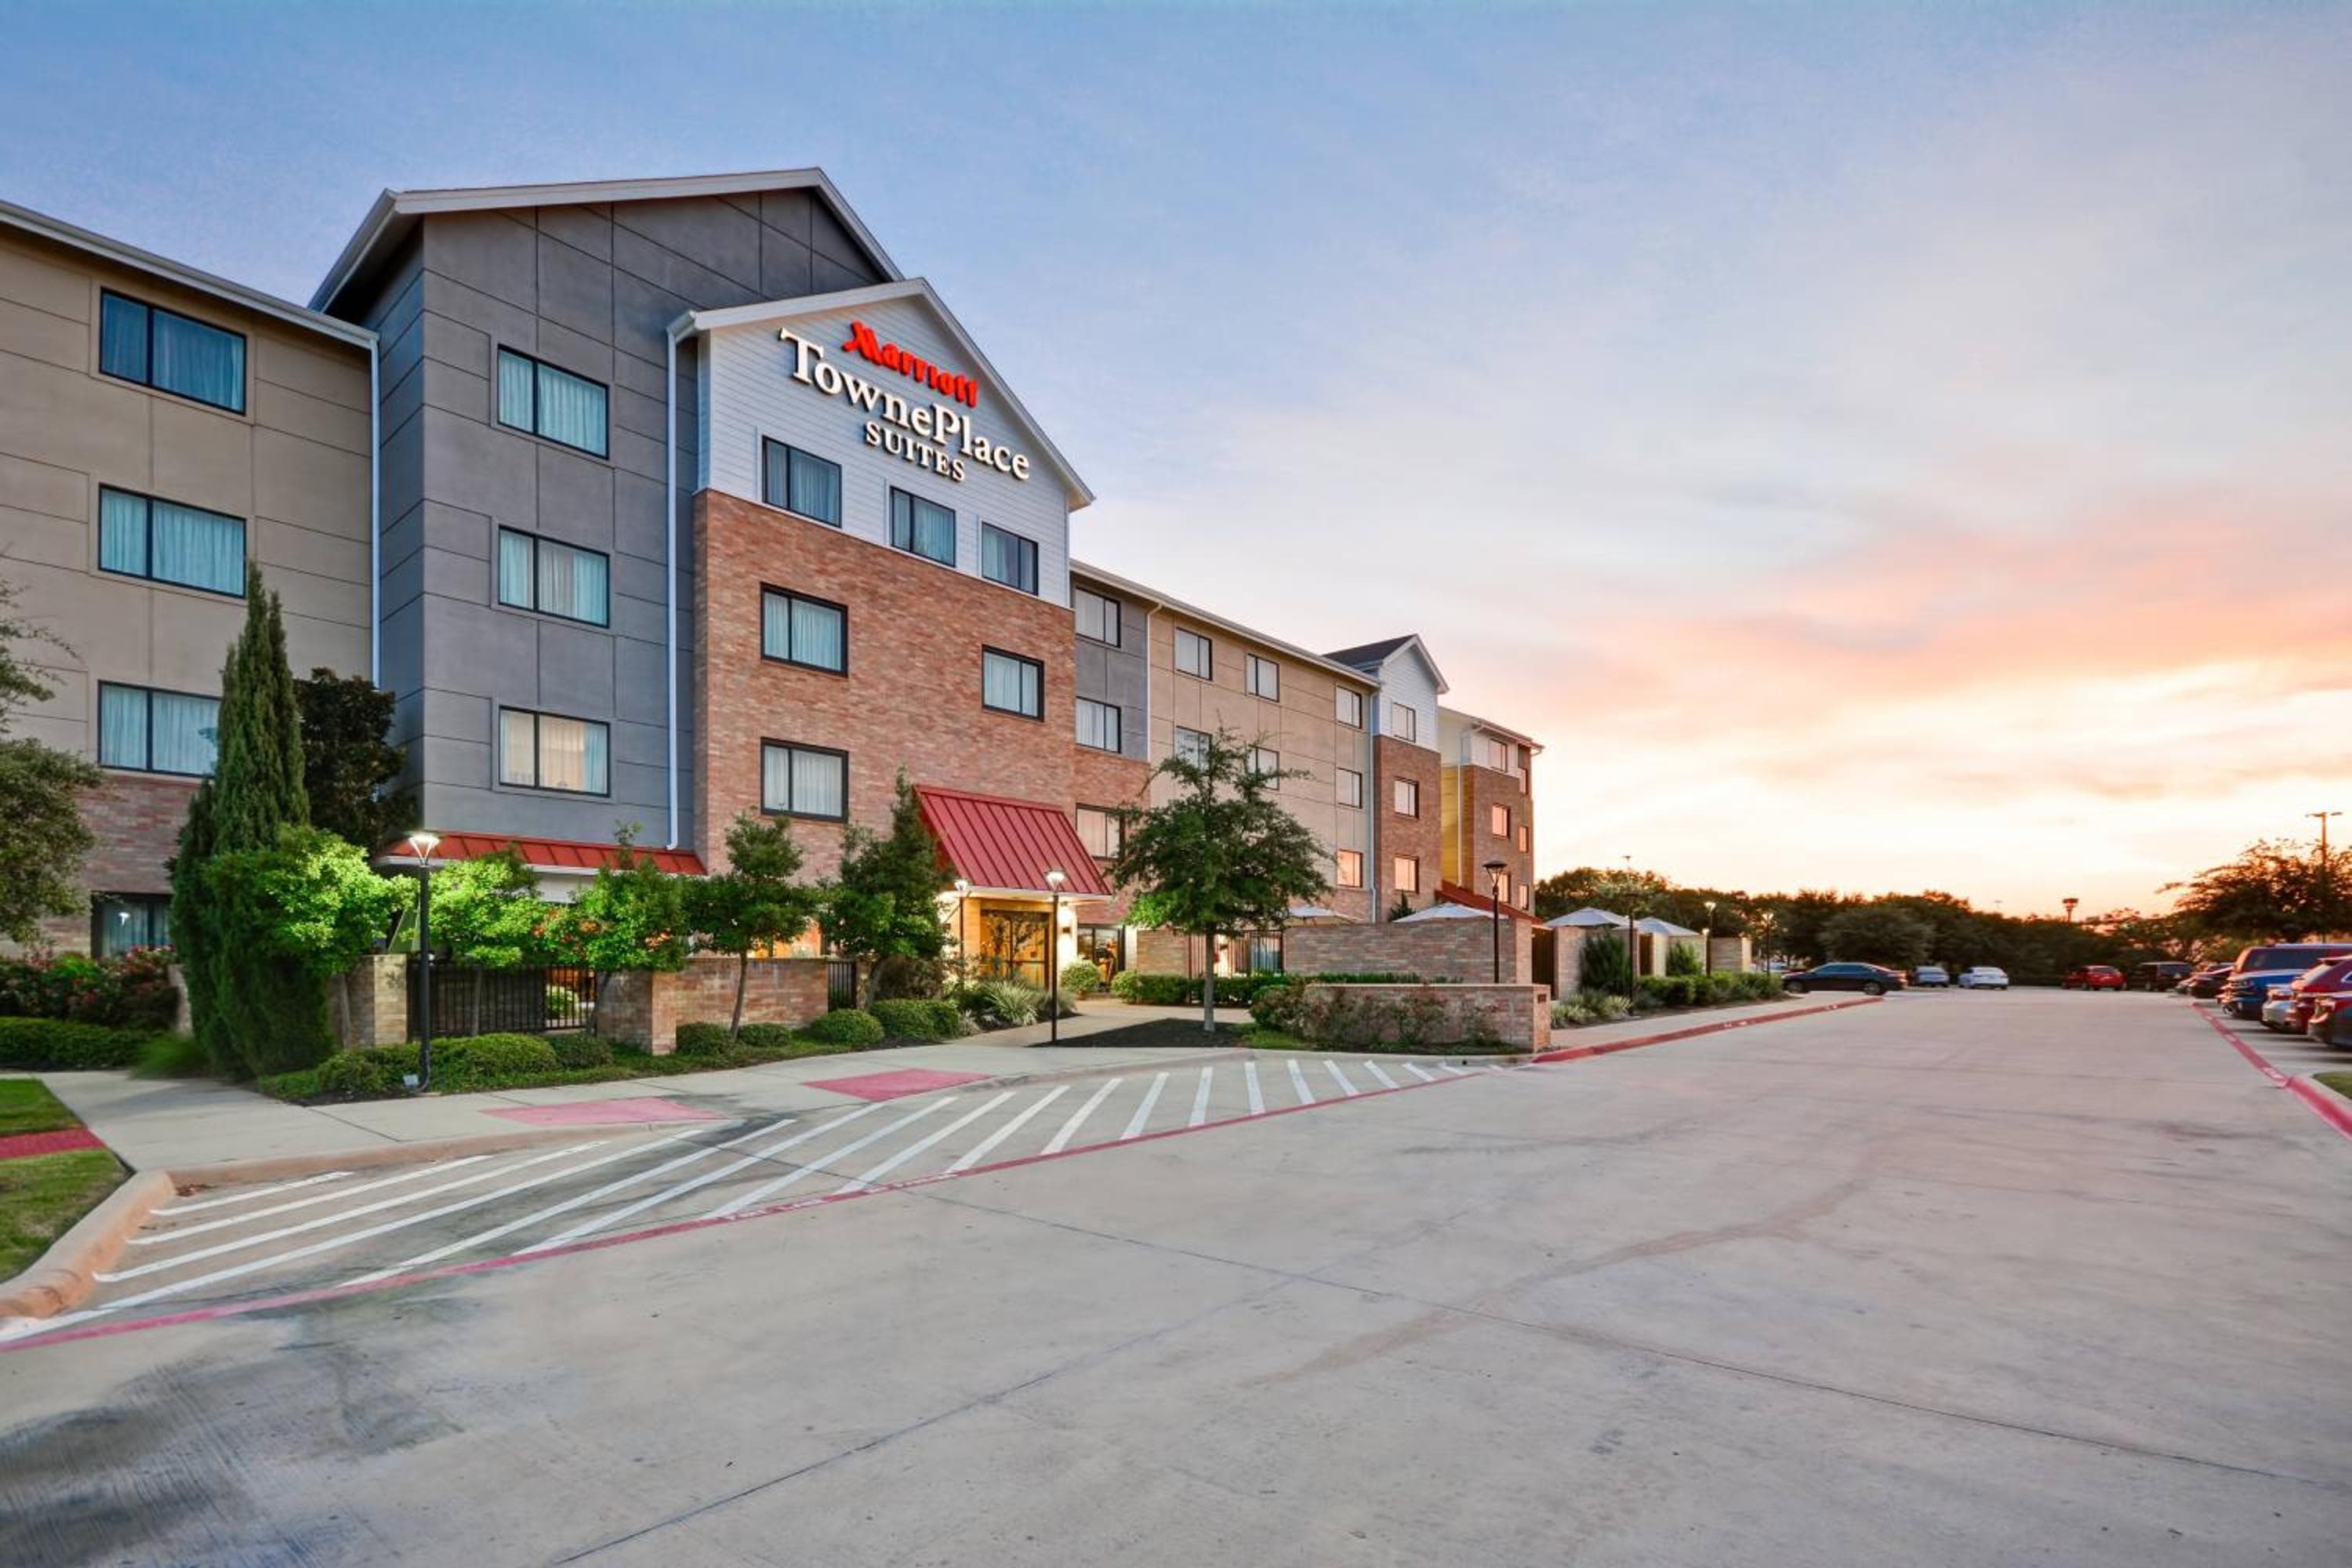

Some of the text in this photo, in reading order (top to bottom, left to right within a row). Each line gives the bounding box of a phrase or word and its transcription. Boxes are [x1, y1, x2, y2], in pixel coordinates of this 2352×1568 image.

[779, 327, 1029, 481] TownePlace
[841, 320, 978, 408] Marriott
[865, 419, 965, 482] SUITES
